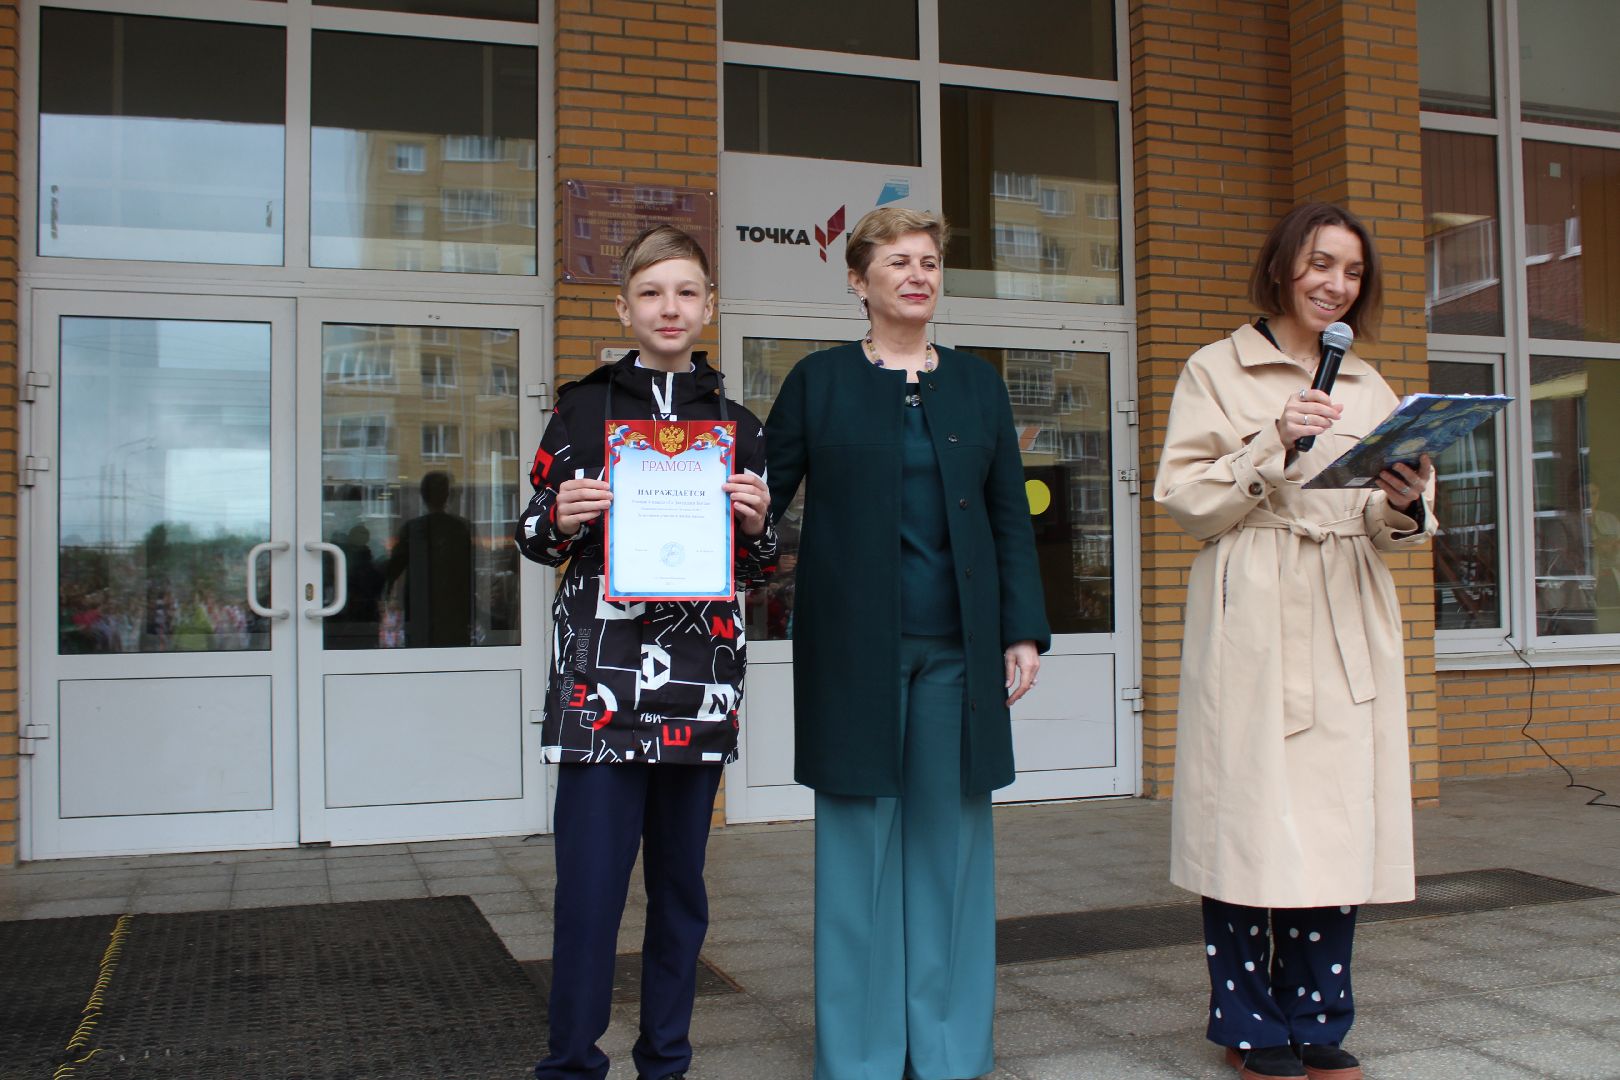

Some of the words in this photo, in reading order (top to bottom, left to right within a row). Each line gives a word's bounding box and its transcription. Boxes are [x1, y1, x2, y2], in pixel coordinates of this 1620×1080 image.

[736, 225, 811, 246] ТОЧКА
[642, 460, 703, 472] ГРАМОТА
[638, 489, 706, 497] НАГРАЖДАЕТСЯ
